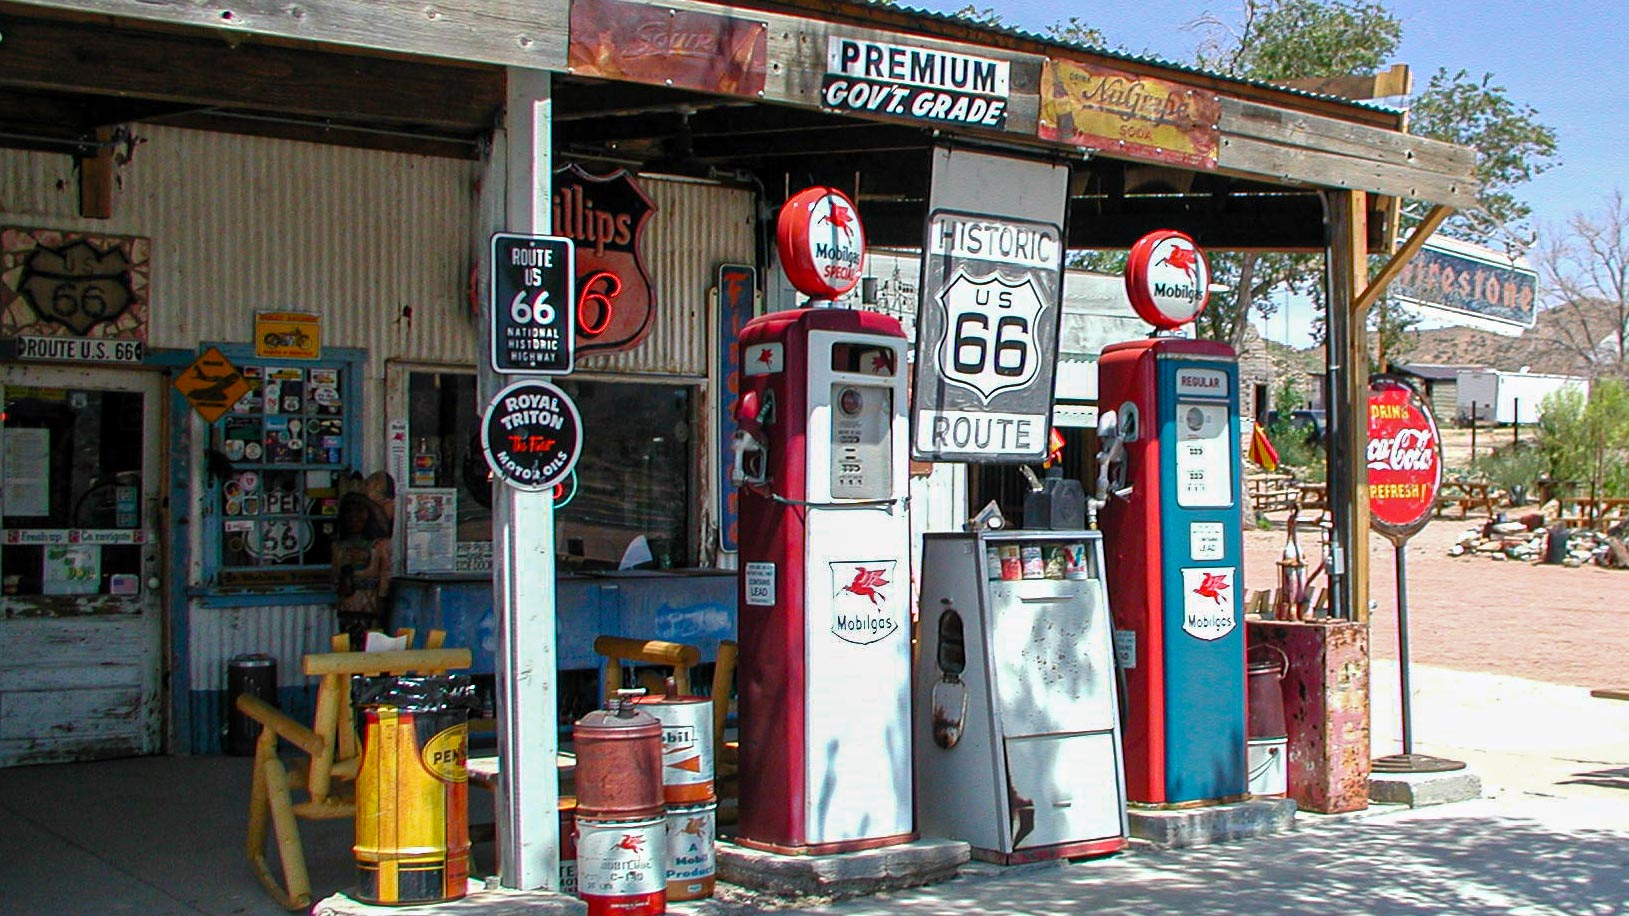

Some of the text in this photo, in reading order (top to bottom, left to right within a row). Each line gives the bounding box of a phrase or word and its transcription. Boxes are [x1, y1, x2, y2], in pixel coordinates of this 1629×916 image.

[841, 40, 997, 93] PREMIUM
[826, 80, 1005, 126] GOV'T. GRADE
[1119, 124, 1152, 141] SODA
[553, 184, 632, 256] illips
[939, 219, 1051, 262] HISTORIC
[512, 248, 553, 268] ROUTE
[815, 242, 860, 267] Mobilgas
[525, 268, 541, 286] US
[53, 283, 107, 318] 66
[577, 270, 623, 337] 6
[1154, 283, 1203, 304] Mobilgas
[511, 290, 555, 324] 66
[507, 327, 559, 338] NATIONAL
[27, 339, 134, 360] ROUTE U.S. 66
[507, 339, 558, 350] HISTORIC
[953, 312, 1028, 377] 66
[511, 352, 556, 362] HIGHWAY
[1181, 376, 1220, 388] REGULAR
[505, 394, 560, 413] ROYAL
[500, 410, 564, 430] TRITON
[932, 416, 1031, 449] ROUTE
[497, 451, 568, 480] MOTOR OILS
[751, 587, 768, 596] LEAD
[837, 615, 892, 634] Mobilgas
[1188, 614, 1232, 632] Mobilgas
[688, 843, 698, 852] A
[675, 854, 708, 866] Mobil
